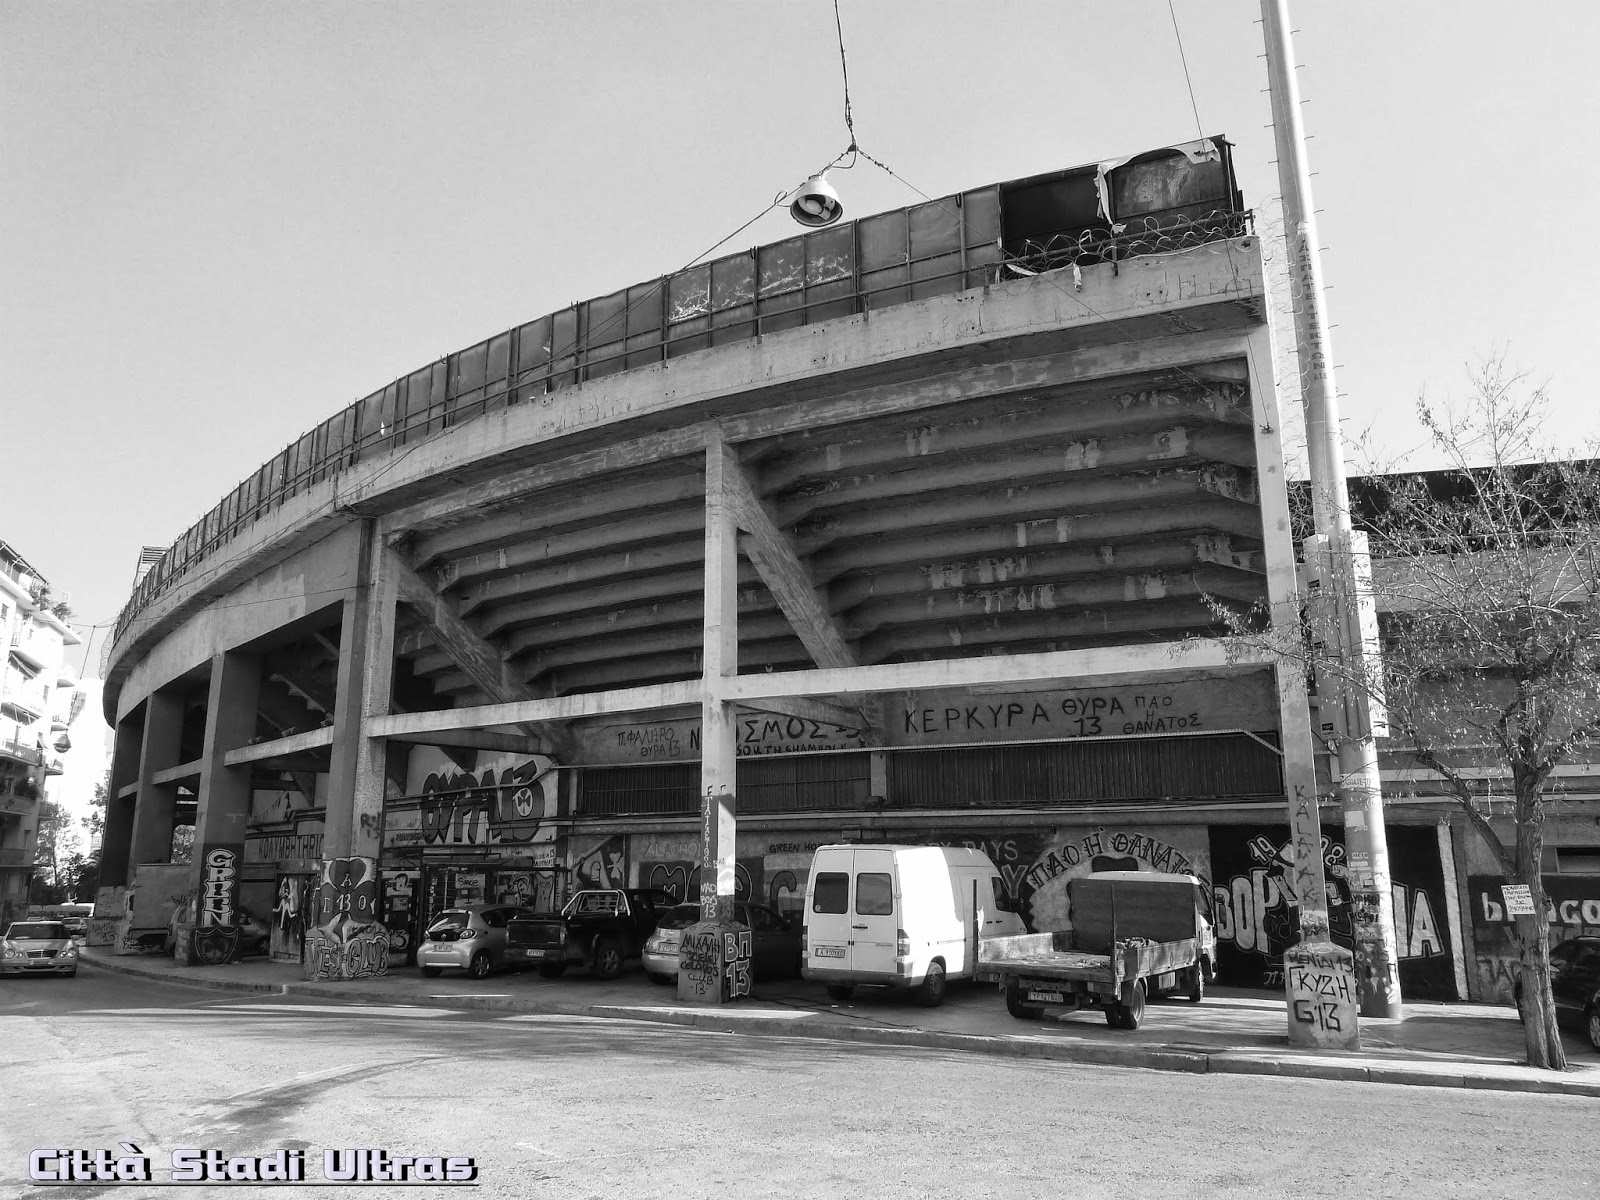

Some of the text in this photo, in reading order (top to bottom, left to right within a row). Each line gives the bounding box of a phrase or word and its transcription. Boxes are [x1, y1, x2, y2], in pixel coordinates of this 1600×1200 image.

[1133, 695, 1173, 709] ΠΑΟ
[905, 697, 1124, 734] ΚΕΡΚΥΡΑ ΘΥΡΑ
[1074, 716, 1103, 737] 13
[1122, 712, 1203, 735] ΘΑΝΑΤΟΣ
[769, 843, 800, 854] GREEN
[725, 958, 751, 998] 13
